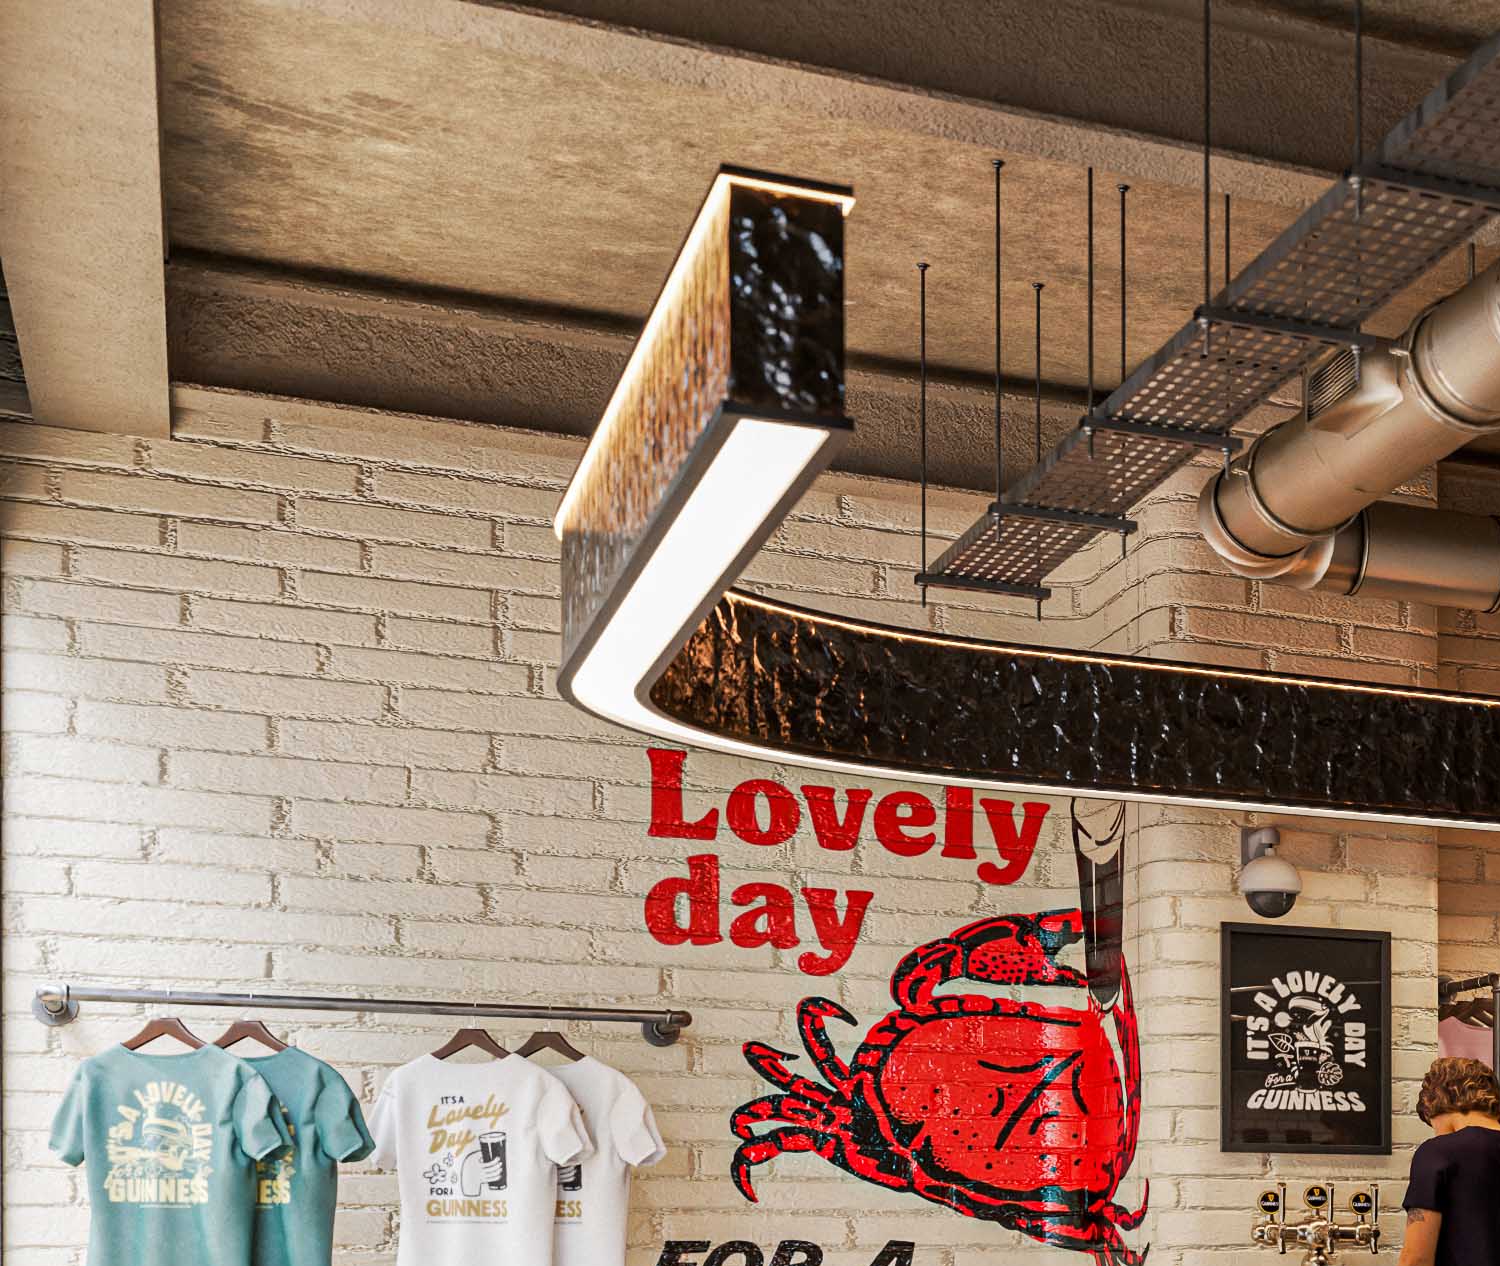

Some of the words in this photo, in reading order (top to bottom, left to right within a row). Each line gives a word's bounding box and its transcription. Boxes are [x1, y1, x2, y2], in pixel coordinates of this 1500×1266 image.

[646, 748, 1050, 885] Lovely
[644, 855, 874, 976] day
[1254, 992, 1278, 1013] A
[1272, 970, 1362, 1014] LOVELY
[1247, 1016, 1270, 1060] IT'S
[1344, 1022, 1366, 1068] DAY
[133, 1081, 207, 1121] LOVELY
[427, 1094, 510, 1128] Lovely
[457, 1096, 465, 1104] A
[1247, 1088, 1366, 1112] GUINNESS
[429, 1129, 476, 1157] Day
[108, 1178, 209, 1204] GUINNESS
[430, 1188, 448, 1196] FOR
[426, 1199, 508, 1218] GUINNESS
